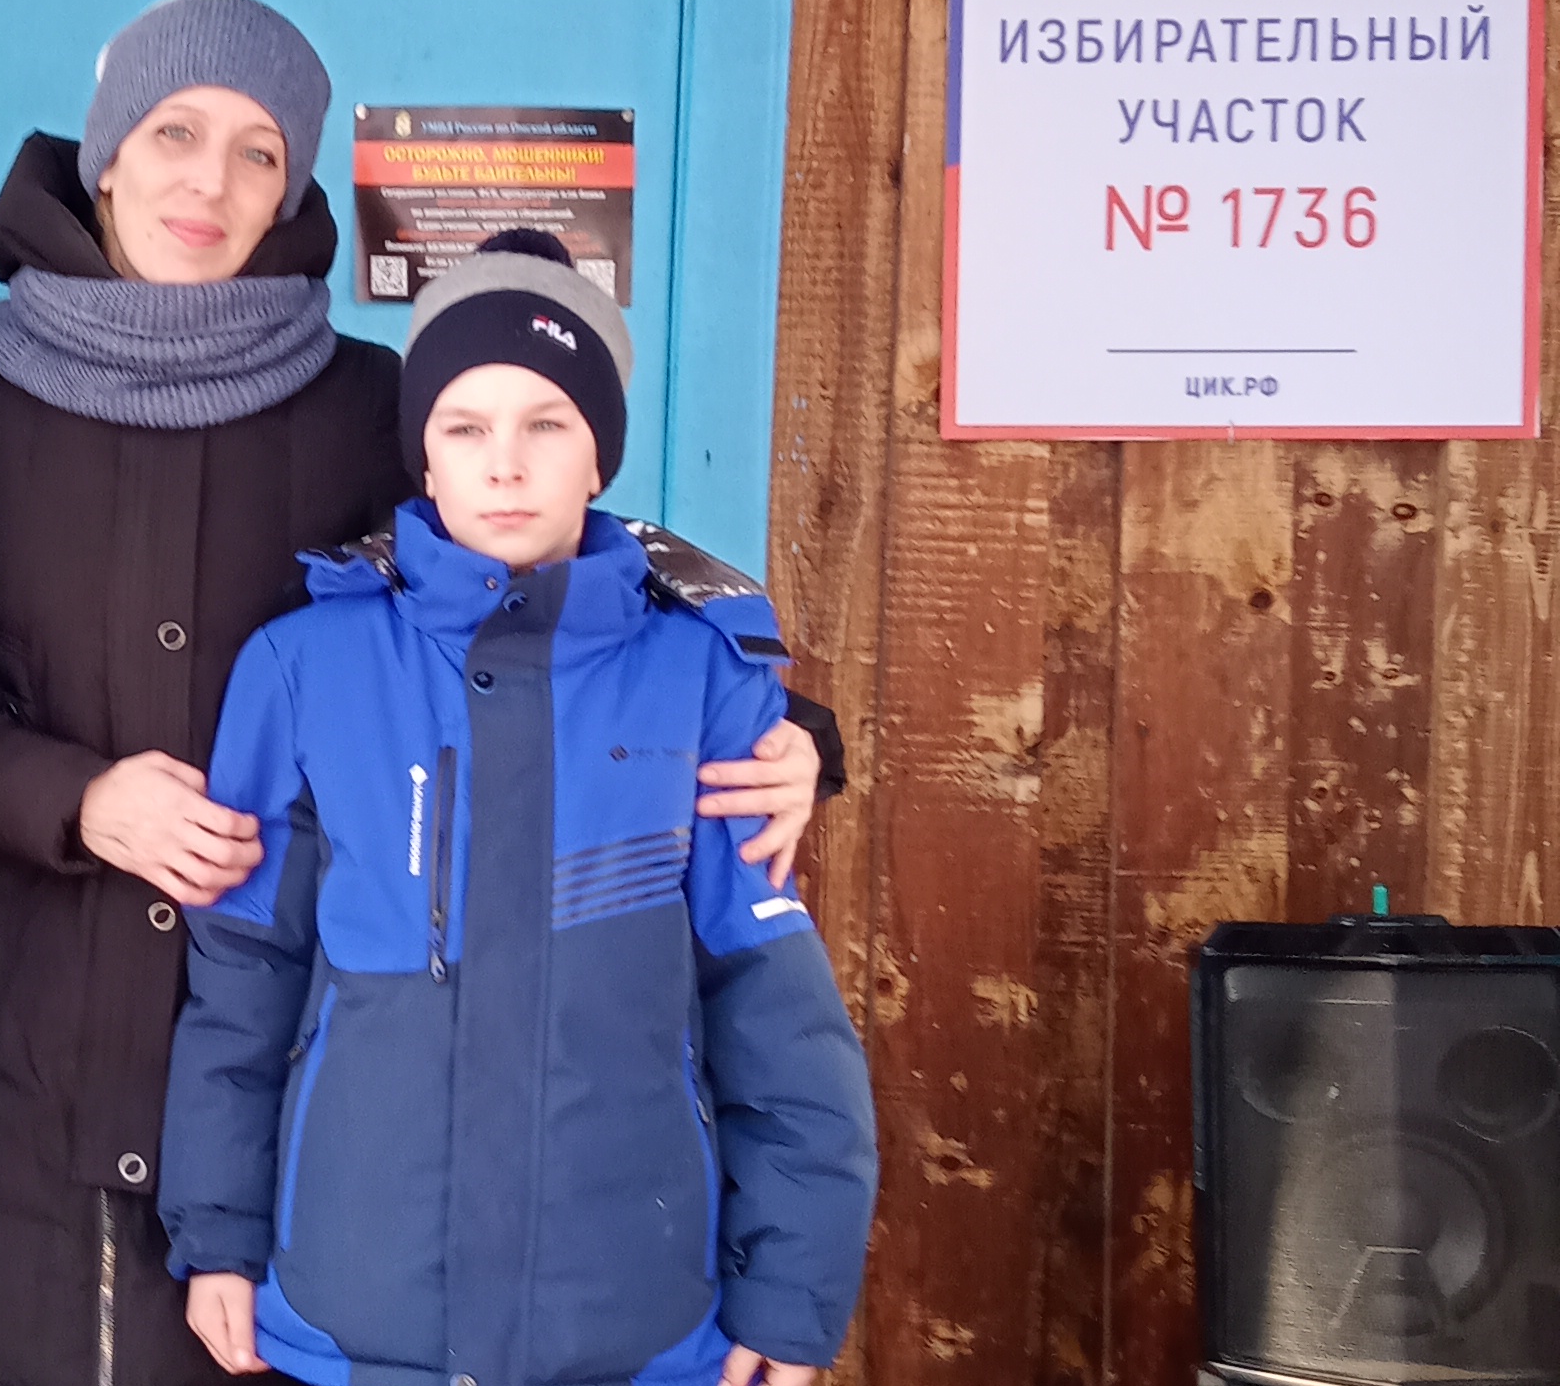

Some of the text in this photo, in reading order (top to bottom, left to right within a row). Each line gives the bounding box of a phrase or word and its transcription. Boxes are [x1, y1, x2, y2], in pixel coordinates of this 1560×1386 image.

[999, 4, 1492, 63] ИЗБИРАТЕЛЬНЫЙ
[1118, 97, 1368, 144] УЧАСТОК
[1105, 184, 1378, 251] № 1736
[531, 314, 578, 351] FILA
[1185, 375, 1280, 398] ЦИК.РФ
